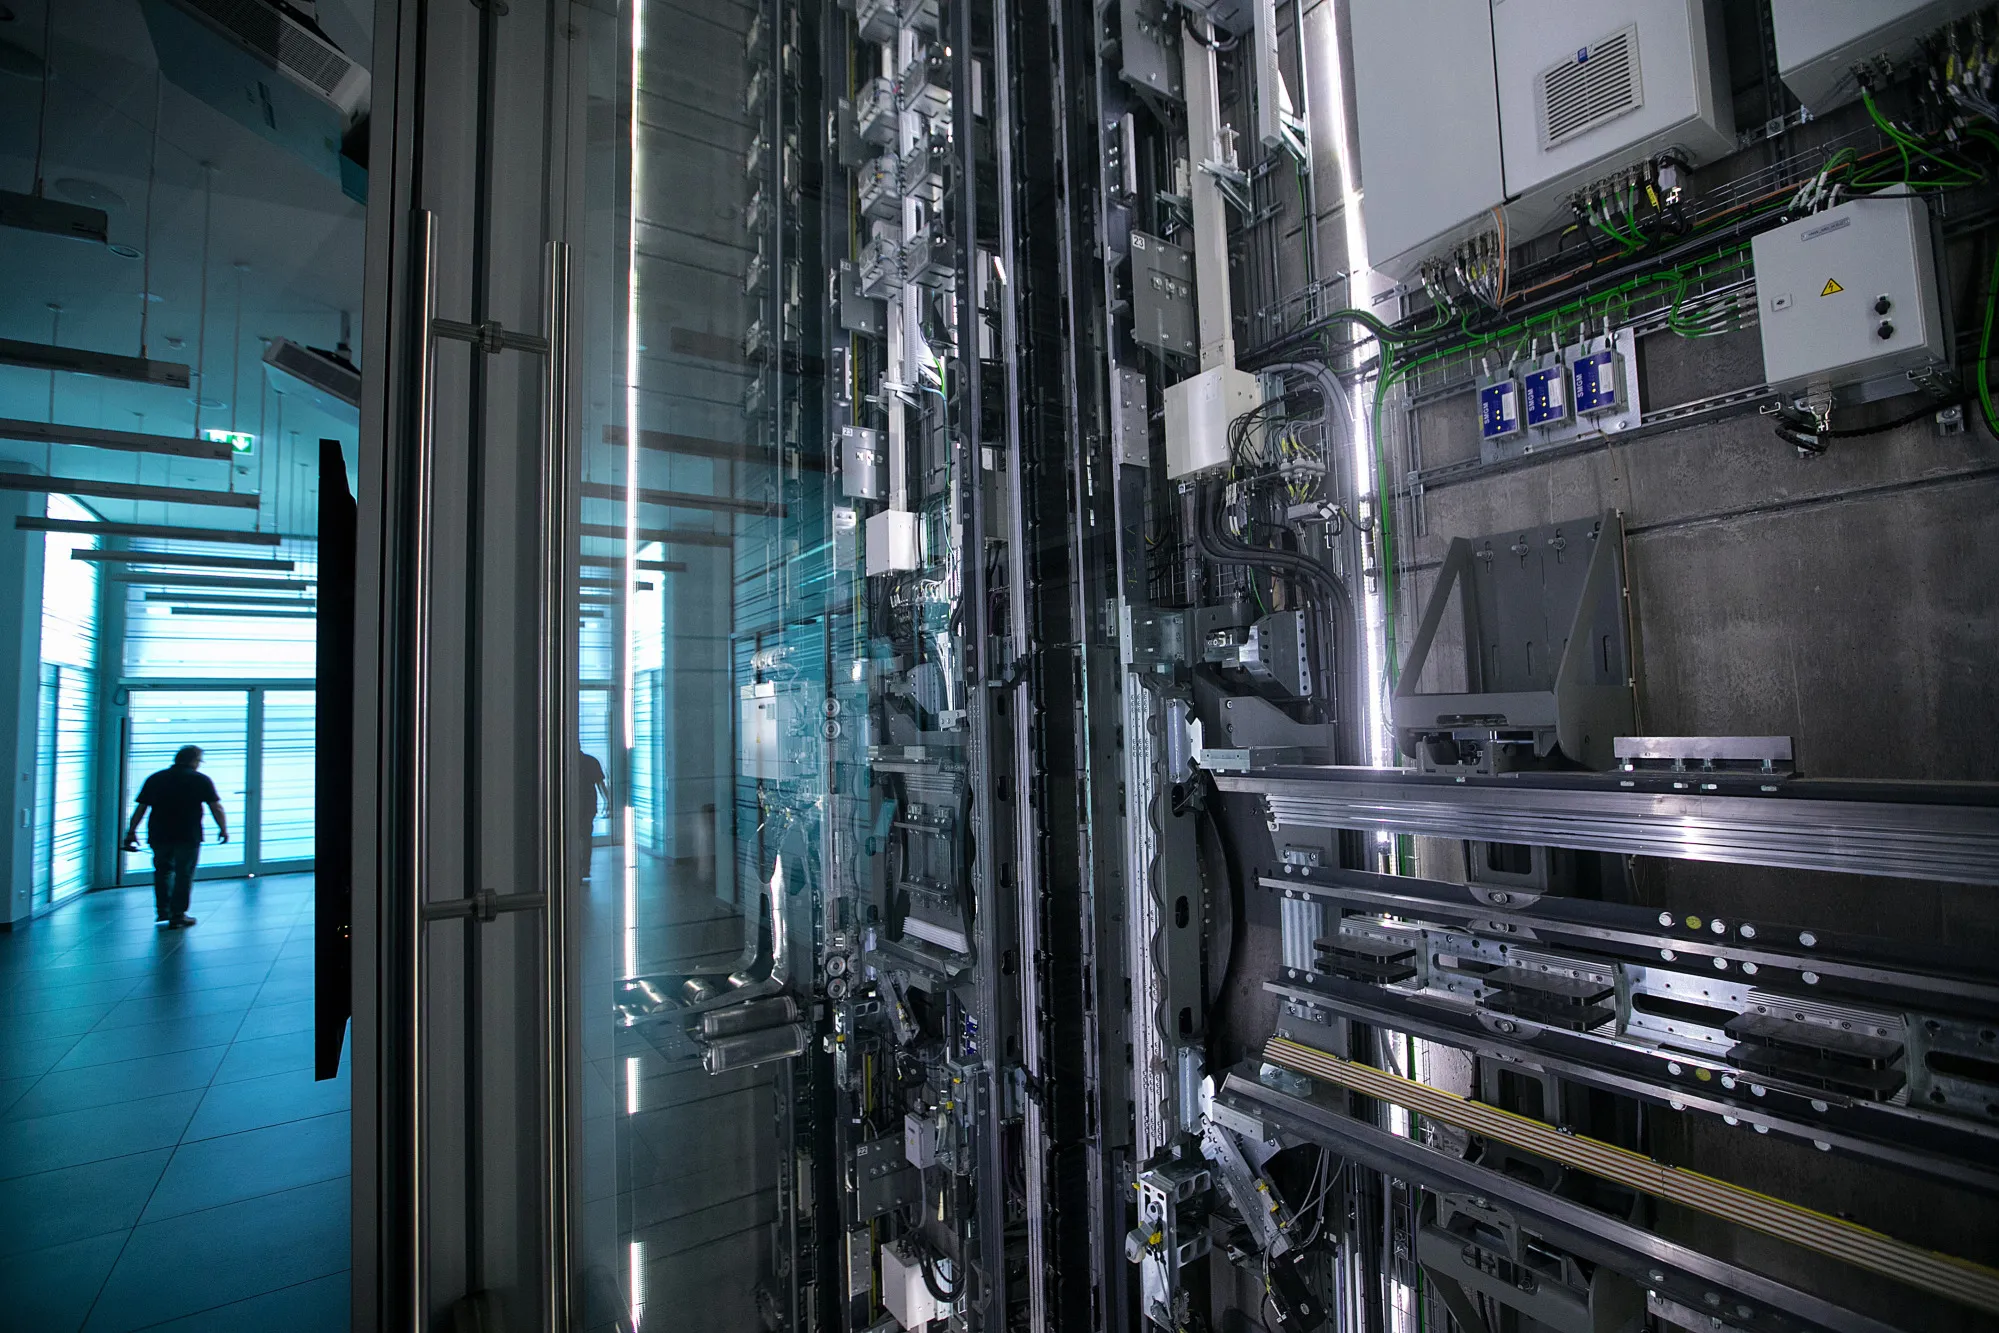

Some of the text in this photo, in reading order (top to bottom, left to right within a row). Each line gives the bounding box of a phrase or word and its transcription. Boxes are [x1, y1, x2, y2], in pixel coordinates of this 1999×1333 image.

[1133, 236, 1144, 247] 23
[1576, 373, 1584, 398] SMGM
[1527, 388, 1535, 412] SMGM
